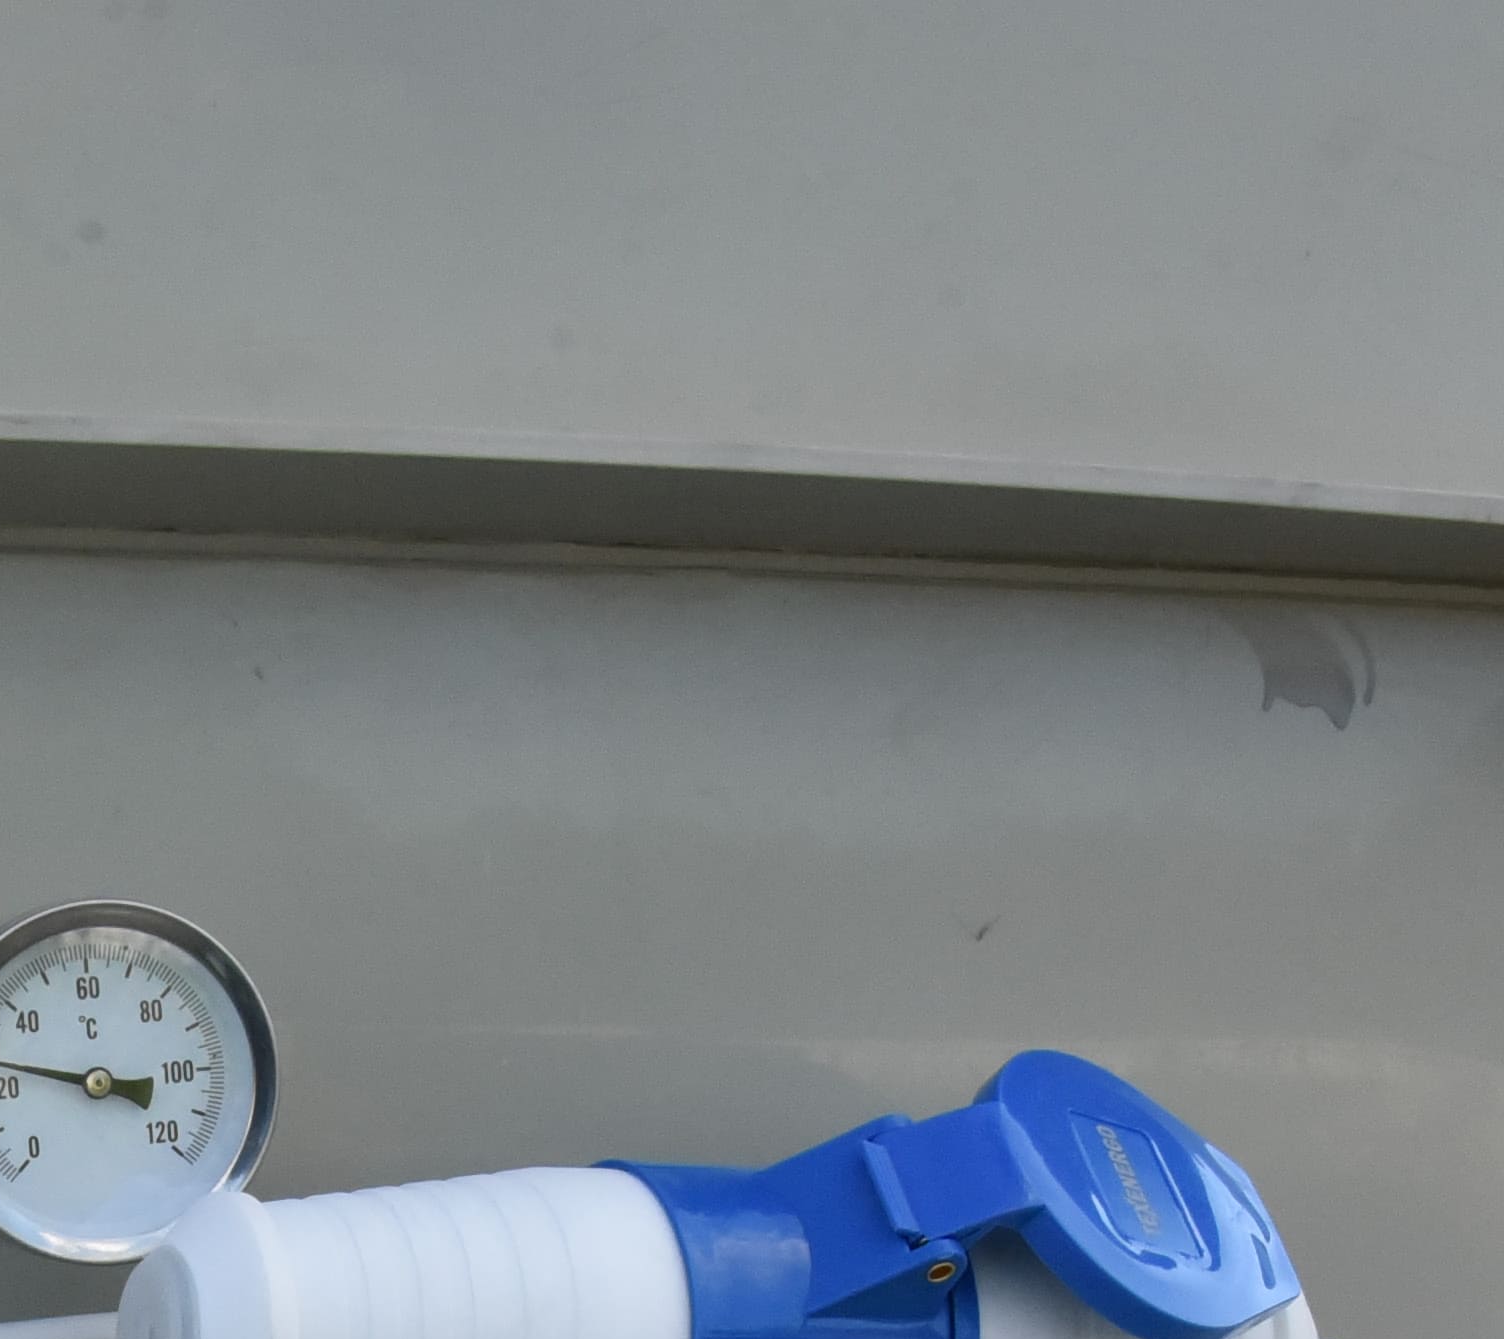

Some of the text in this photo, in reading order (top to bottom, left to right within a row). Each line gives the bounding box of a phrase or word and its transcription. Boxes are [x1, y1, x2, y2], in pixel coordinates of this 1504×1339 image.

[75, 976, 100, 1000] 60
[15, 1010, 40, 1034] 40
[139, 999, 163, 1023] 80
[78, 1015, 98, 1040] °C
[161, 1059, 193, 1085] 100
[146, 1119, 179, 1145] 120
[28, 1135, 40, 1158] 0
